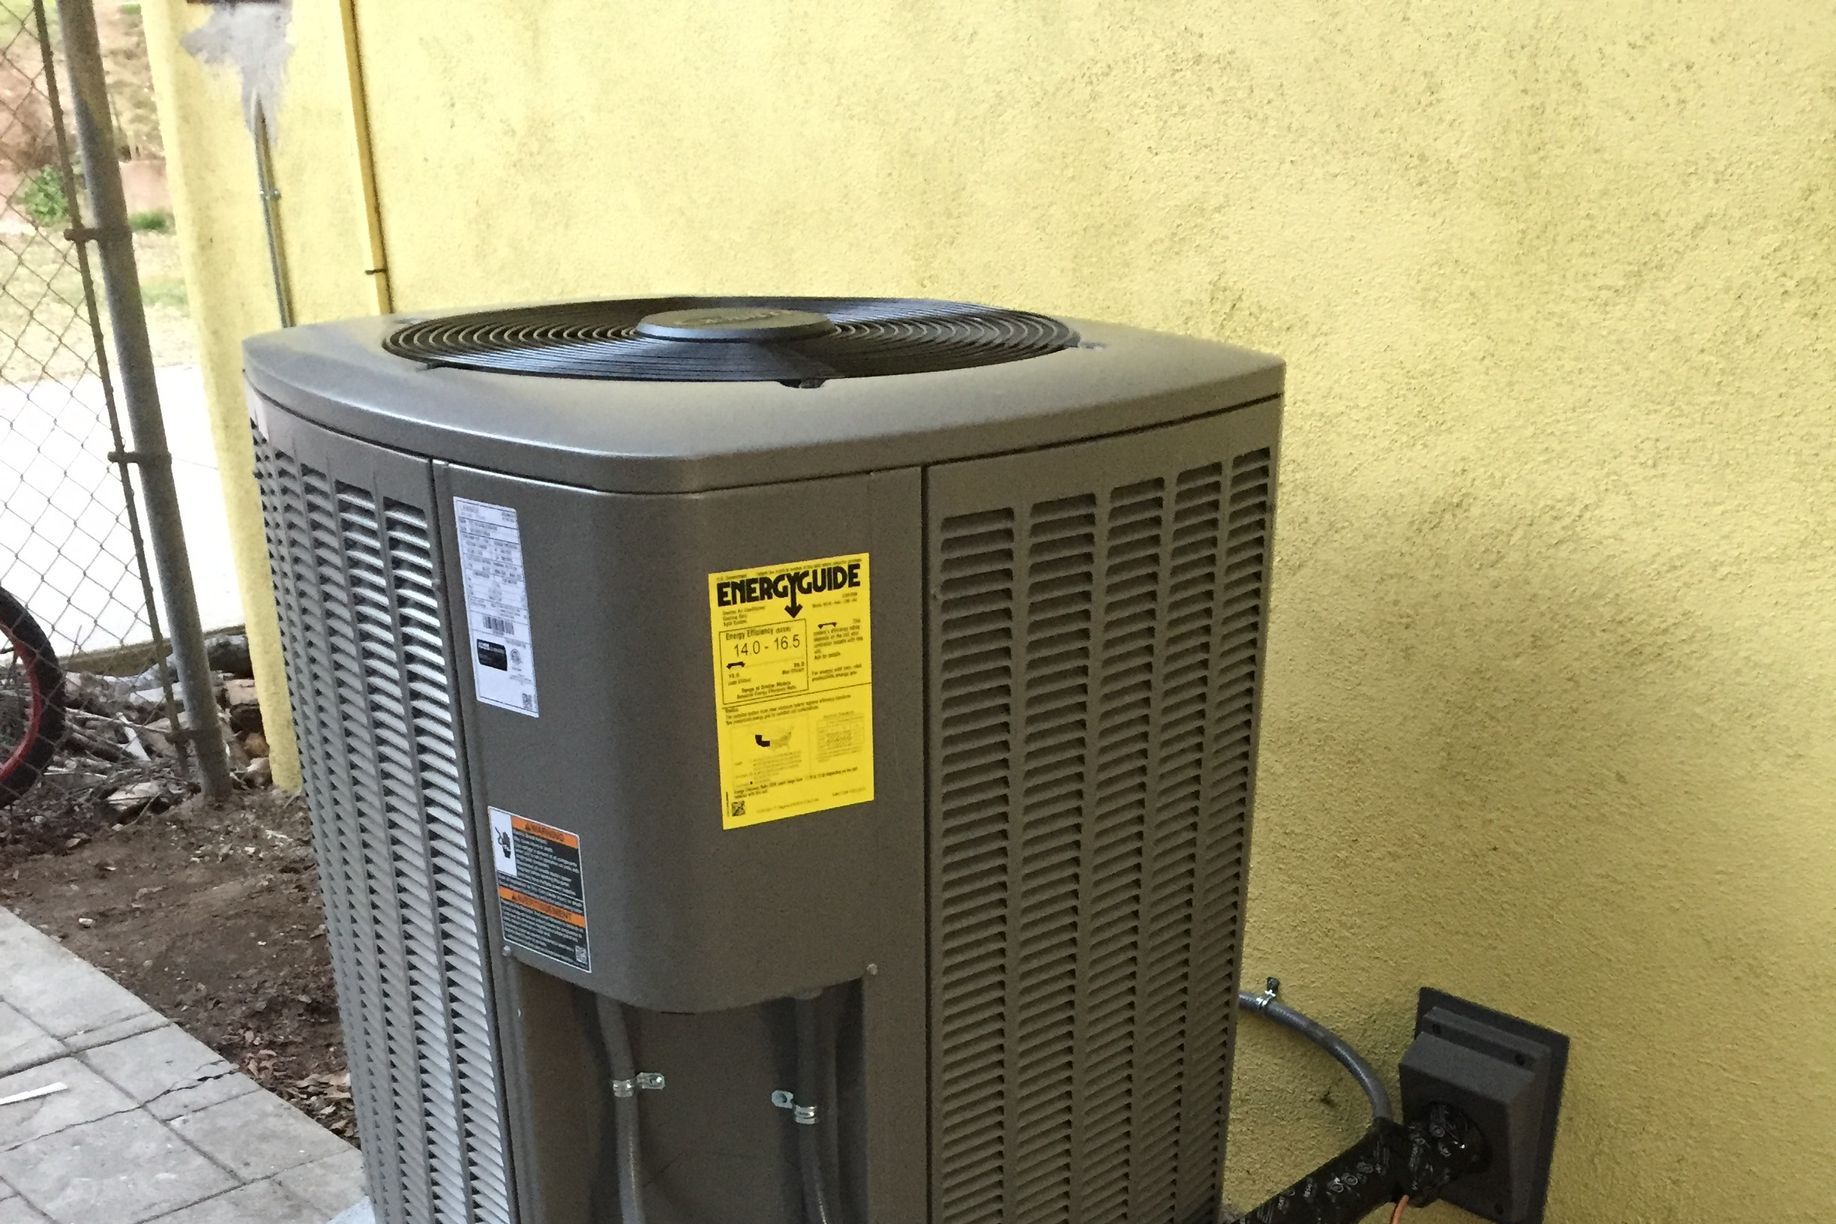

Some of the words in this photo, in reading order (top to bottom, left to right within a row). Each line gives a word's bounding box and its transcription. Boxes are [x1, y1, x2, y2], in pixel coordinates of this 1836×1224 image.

[717, 563, 861, 608] ENERGYGUIDE
[734, 640, 761, 657] 14.0
[774, 634, 801, 651] 16.5
